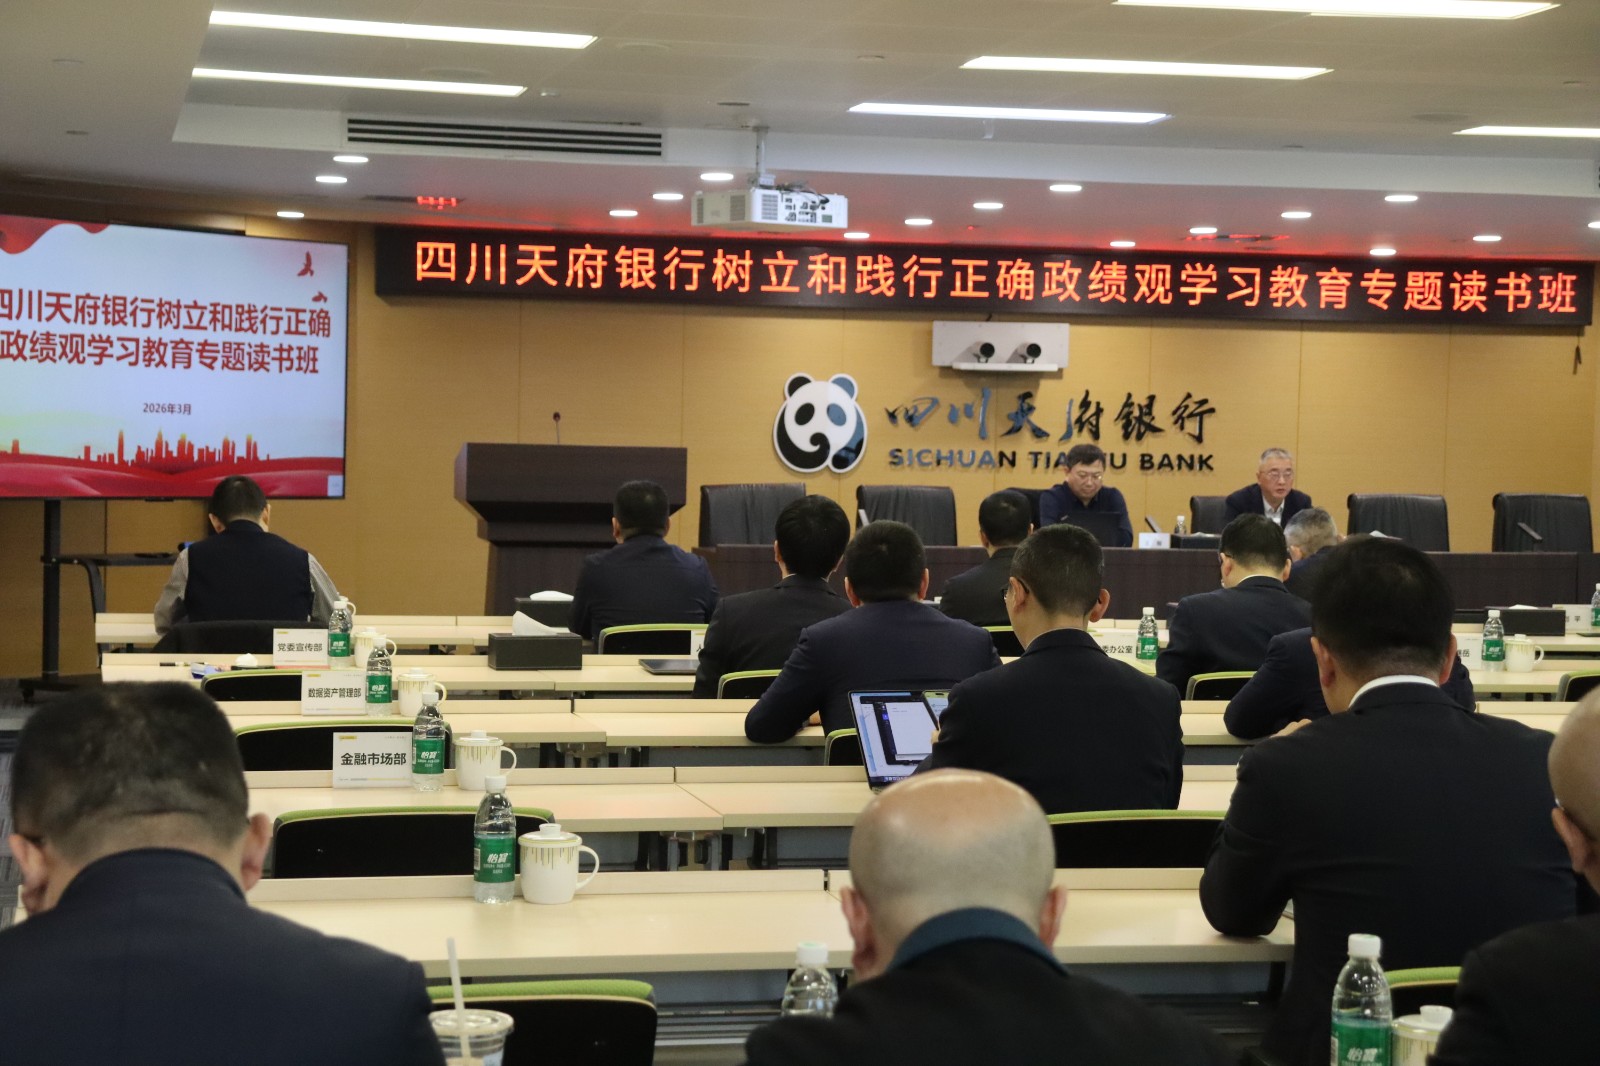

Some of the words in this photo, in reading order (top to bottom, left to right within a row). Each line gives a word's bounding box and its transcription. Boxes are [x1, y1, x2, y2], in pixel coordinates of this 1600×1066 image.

[415, 240, 1577, 314] 四川天府银行树立和践行正确政绩观学习教育专题读书班
[0, 329, 319, 375] 政绩观学习教育专题读书班
[143, 402, 192, 416] 2026年3月
[888, 448, 1017, 468] SICHUAN
[1029, 451, 1127, 470] TIAU
[1139, 452, 1215, 471] BANK
[277, 643, 323, 652] 党委宣传部
[1102, 644, 1133, 654] 委办公室
[307, 687, 362, 698] 数据资产管理部
[340, 752, 407, 766] 金融市场部
